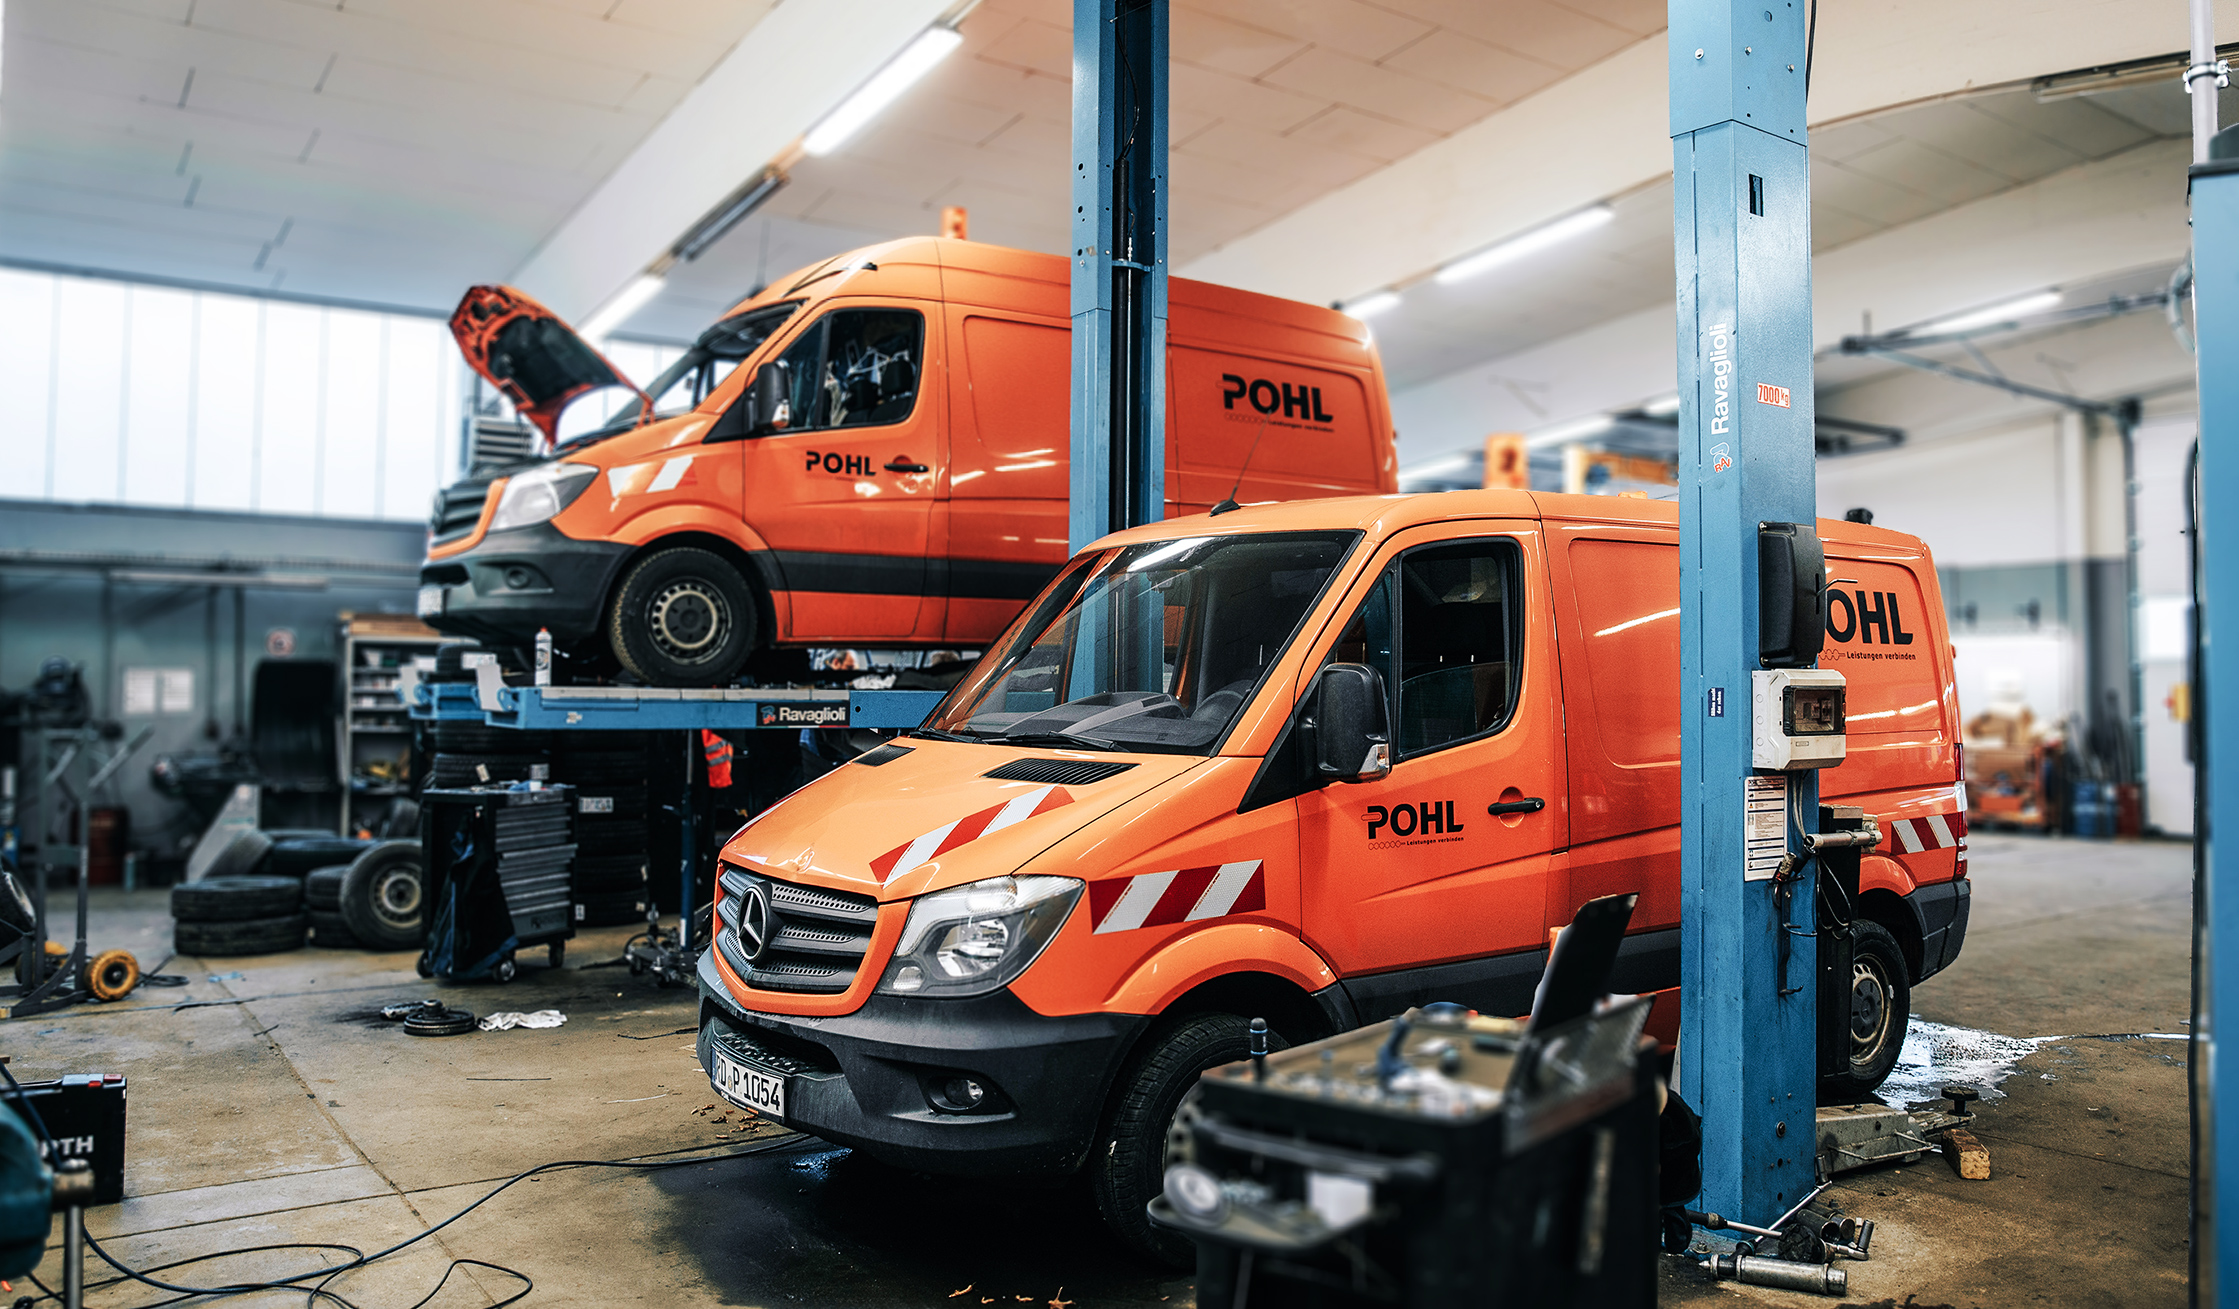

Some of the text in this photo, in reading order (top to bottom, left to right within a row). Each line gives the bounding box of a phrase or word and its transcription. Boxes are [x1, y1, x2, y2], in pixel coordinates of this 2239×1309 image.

[1709, 323, 1732, 435] Ravaglioli
[1222, 373, 1334, 423] POHL
[1758, 384, 1789, 407] 7000 kg
[806, 451, 877, 476] POHL
[1714, 457, 1731, 473] RAV
[1825, 589, 1913, 645] OHL
[1847, 651, 1916, 661] Leistungen verbinden
[779, 707, 847, 724] Ravaglioli
[1367, 800, 1464, 839] POHL
[1406, 838, 1436, 846] Leistungen
[732, 1065, 740, 1094] P
[743, 1071, 781, 1111] 1054
